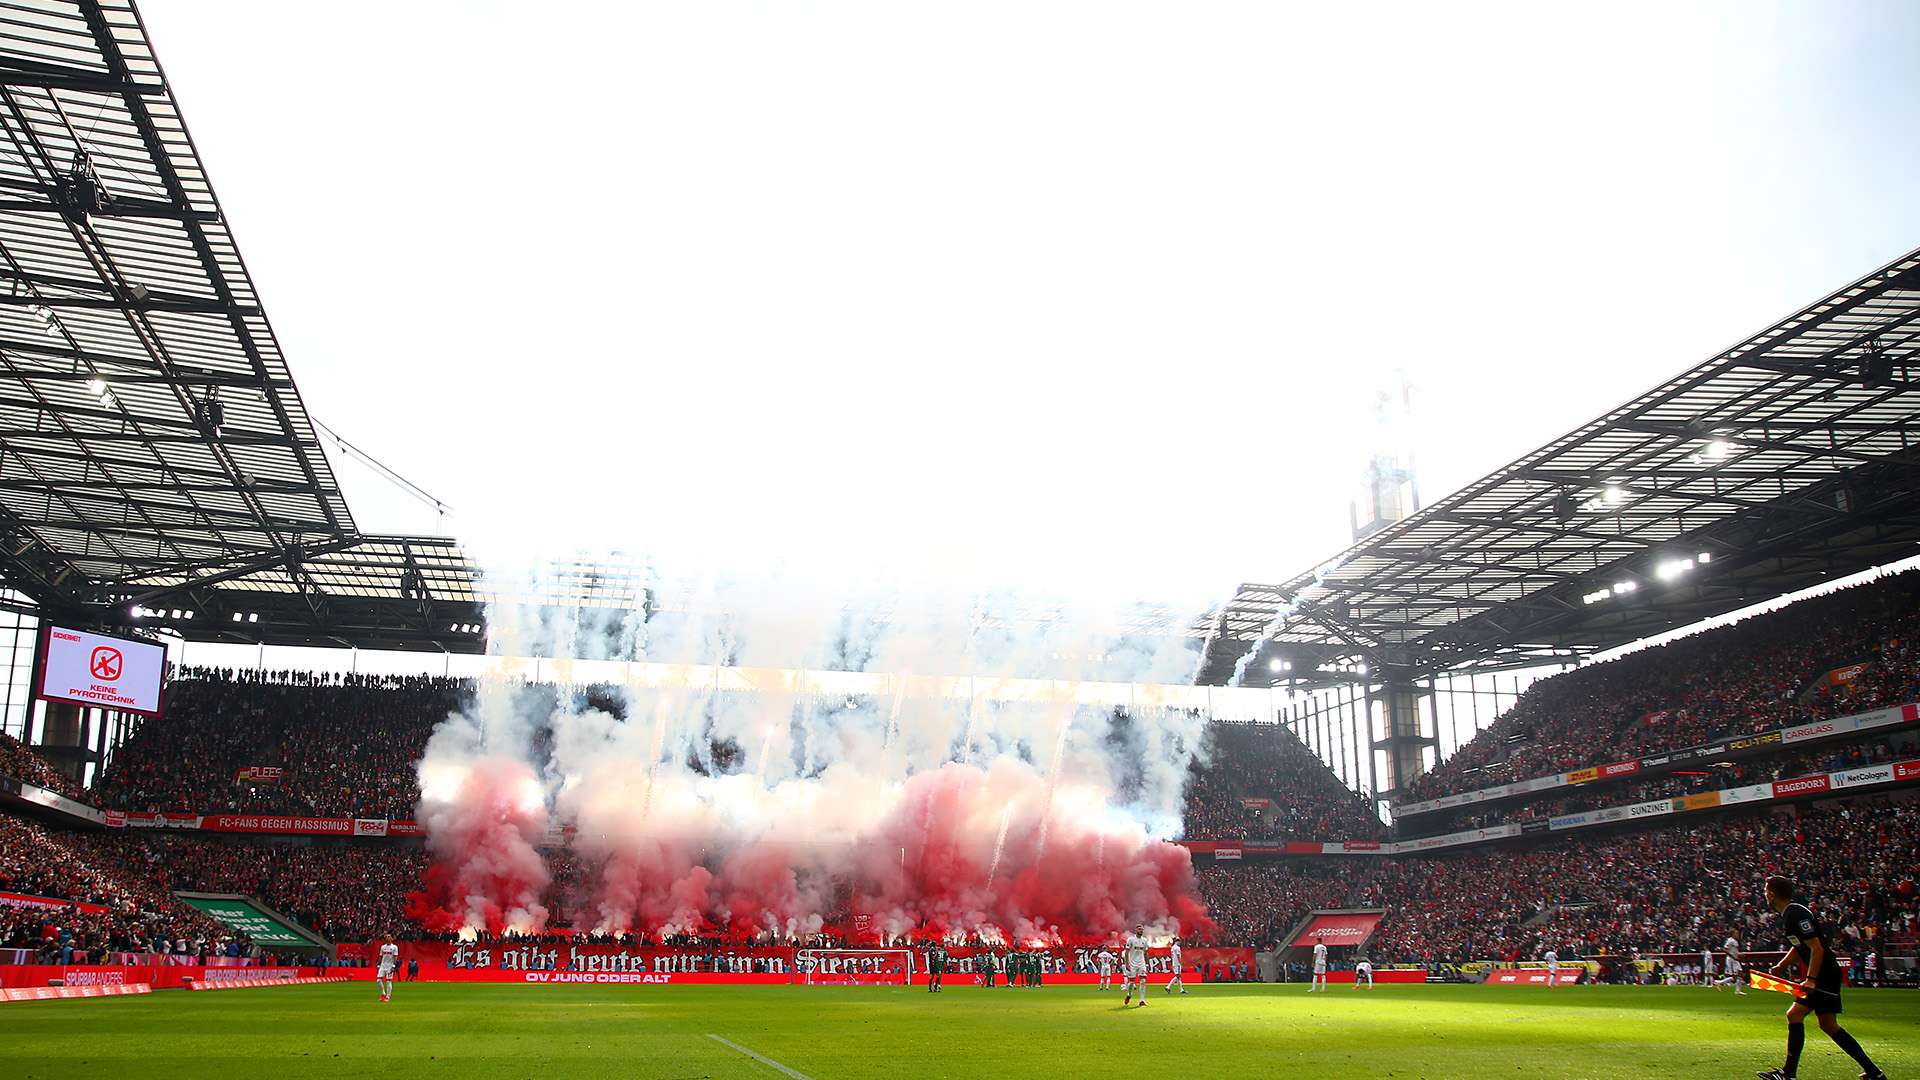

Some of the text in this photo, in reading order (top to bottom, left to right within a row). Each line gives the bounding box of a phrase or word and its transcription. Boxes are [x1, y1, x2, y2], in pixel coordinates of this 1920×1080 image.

[90, 684, 117, 694] KEINE
[69, 688, 135, 705] PYROTECHNIK
[1785, 723, 1833, 739] CARGLASS
[1846, 771, 1889, 783] NetCologne
[1777, 779, 1826, 793] HAGEDORN
[1631, 802, 1670, 816] SUNZINET
[219, 817, 258, 828] FC-FANS
[260, 819, 292, 829] GEGEN
[294, 820, 350, 831] RASSISMUS
[525, 972, 671, 983] OV JUNG ODER ALT
